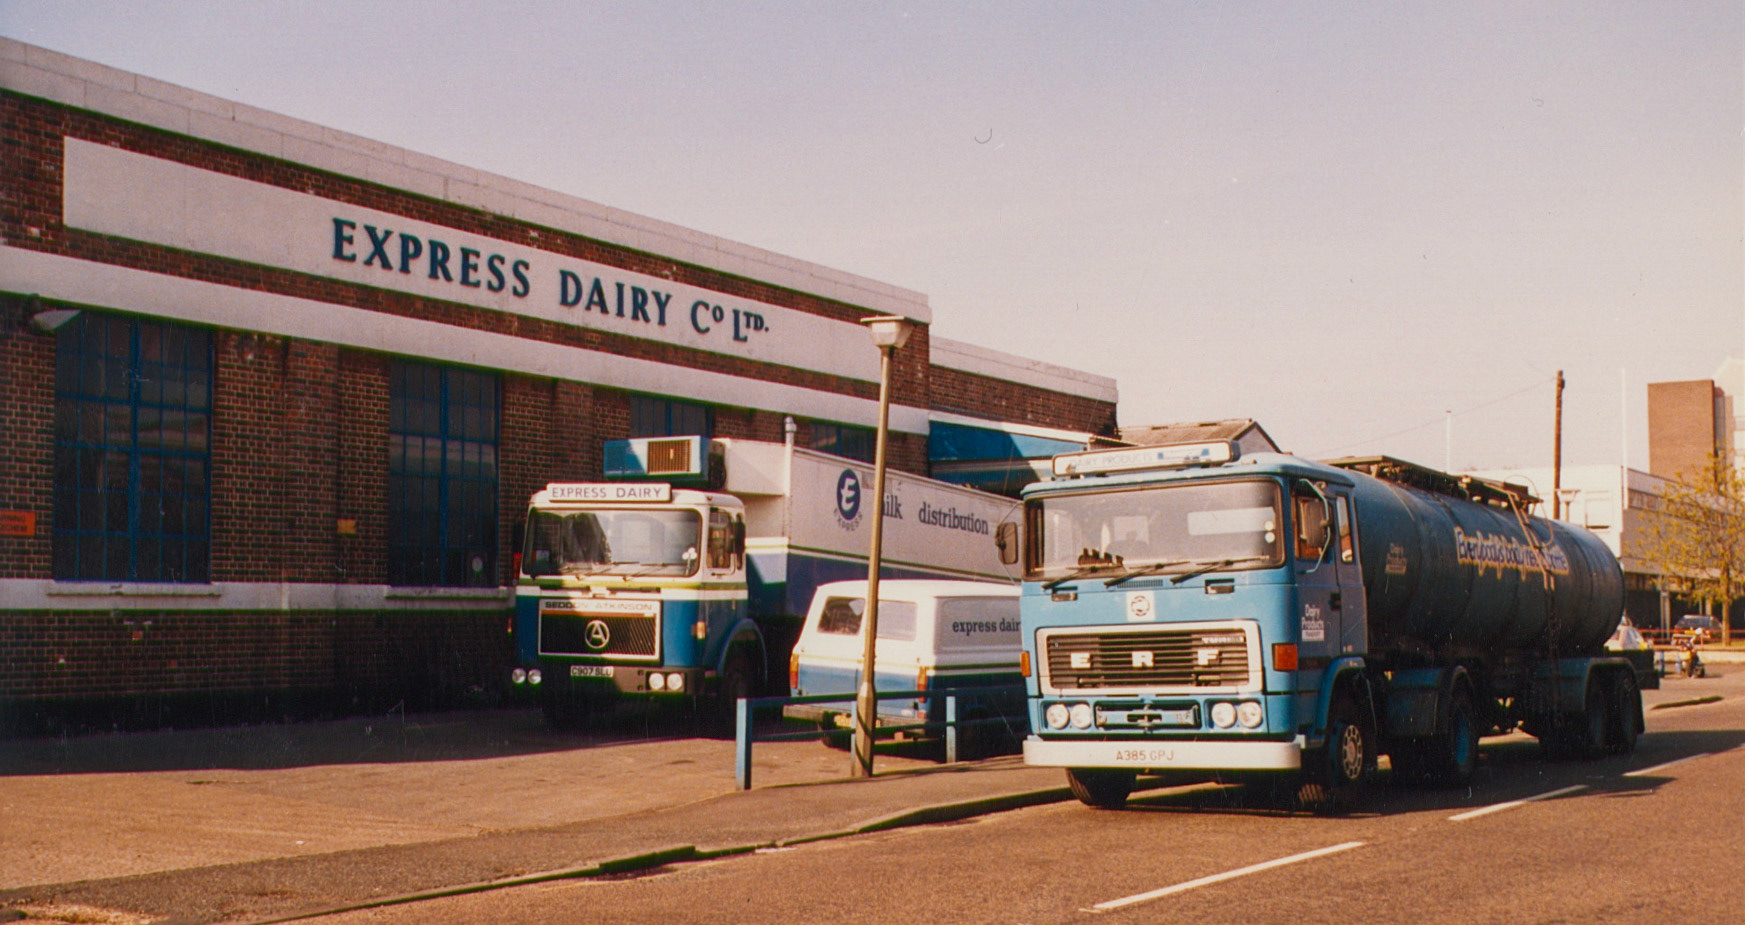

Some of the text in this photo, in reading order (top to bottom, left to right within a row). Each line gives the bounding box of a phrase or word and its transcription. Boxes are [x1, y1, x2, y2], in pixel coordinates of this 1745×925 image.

[332, 217, 530, 298] EXPRESS
[559, 269, 672, 327] DAIRY
[552, 487, 662, 498] EXPRESS DAIRY
[882, 494, 989, 535] ilk distribution
[545, 601, 653, 611] SEDDON ATKINSON
[1305, 604, 1320, 619] Dairy
[952, 617, 1021, 636] express dair
[571, 666, 594, 676] C907
[1115, 750, 1175, 761] A385 GPJ
